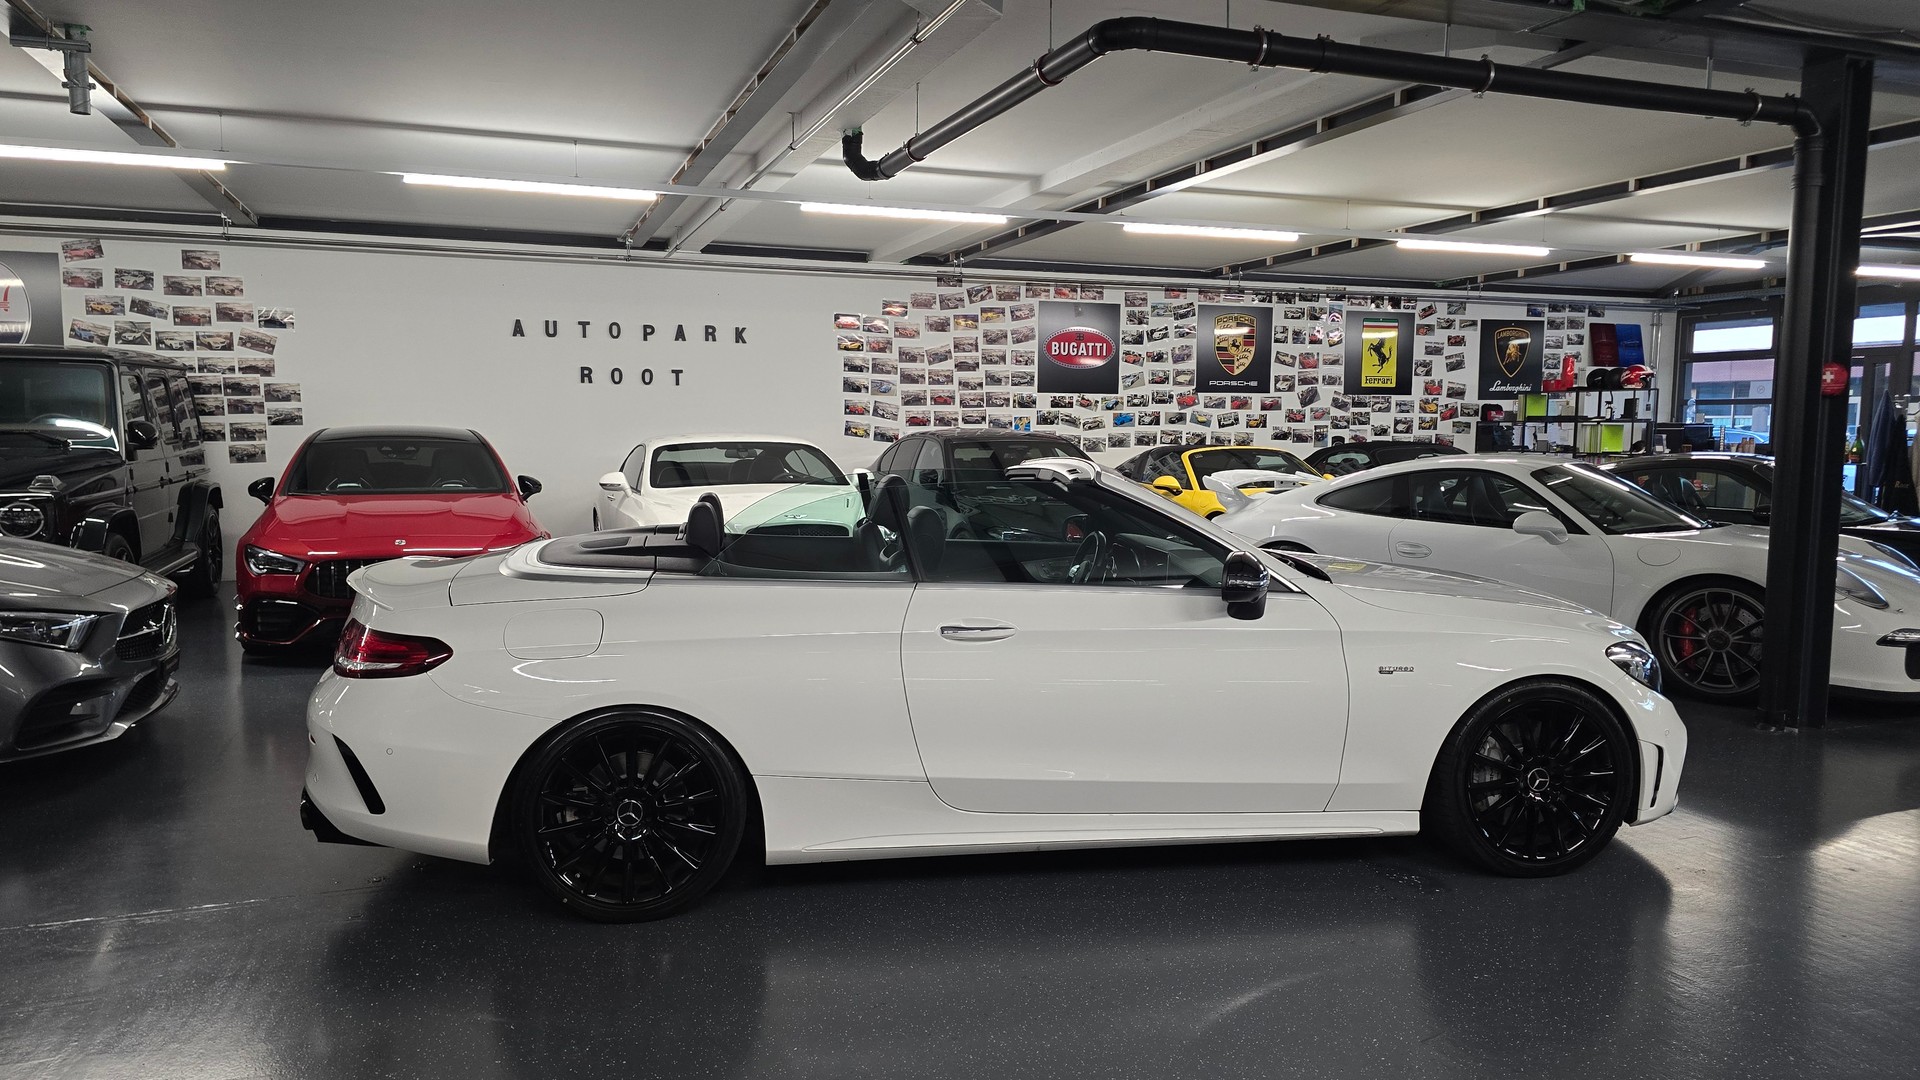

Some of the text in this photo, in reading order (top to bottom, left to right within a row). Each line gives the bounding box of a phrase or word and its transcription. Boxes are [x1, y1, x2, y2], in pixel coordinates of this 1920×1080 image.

[1216, 316, 1254, 325] PORSCHE
[512, 318, 748, 344] AUTOPARK
[1051, 341, 1107, 356] BUGATTI
[579, 366, 684, 386] ROOT
[1364, 375, 1393, 385] Ferrari
[1488, 379, 1532, 394] Lamborghini
